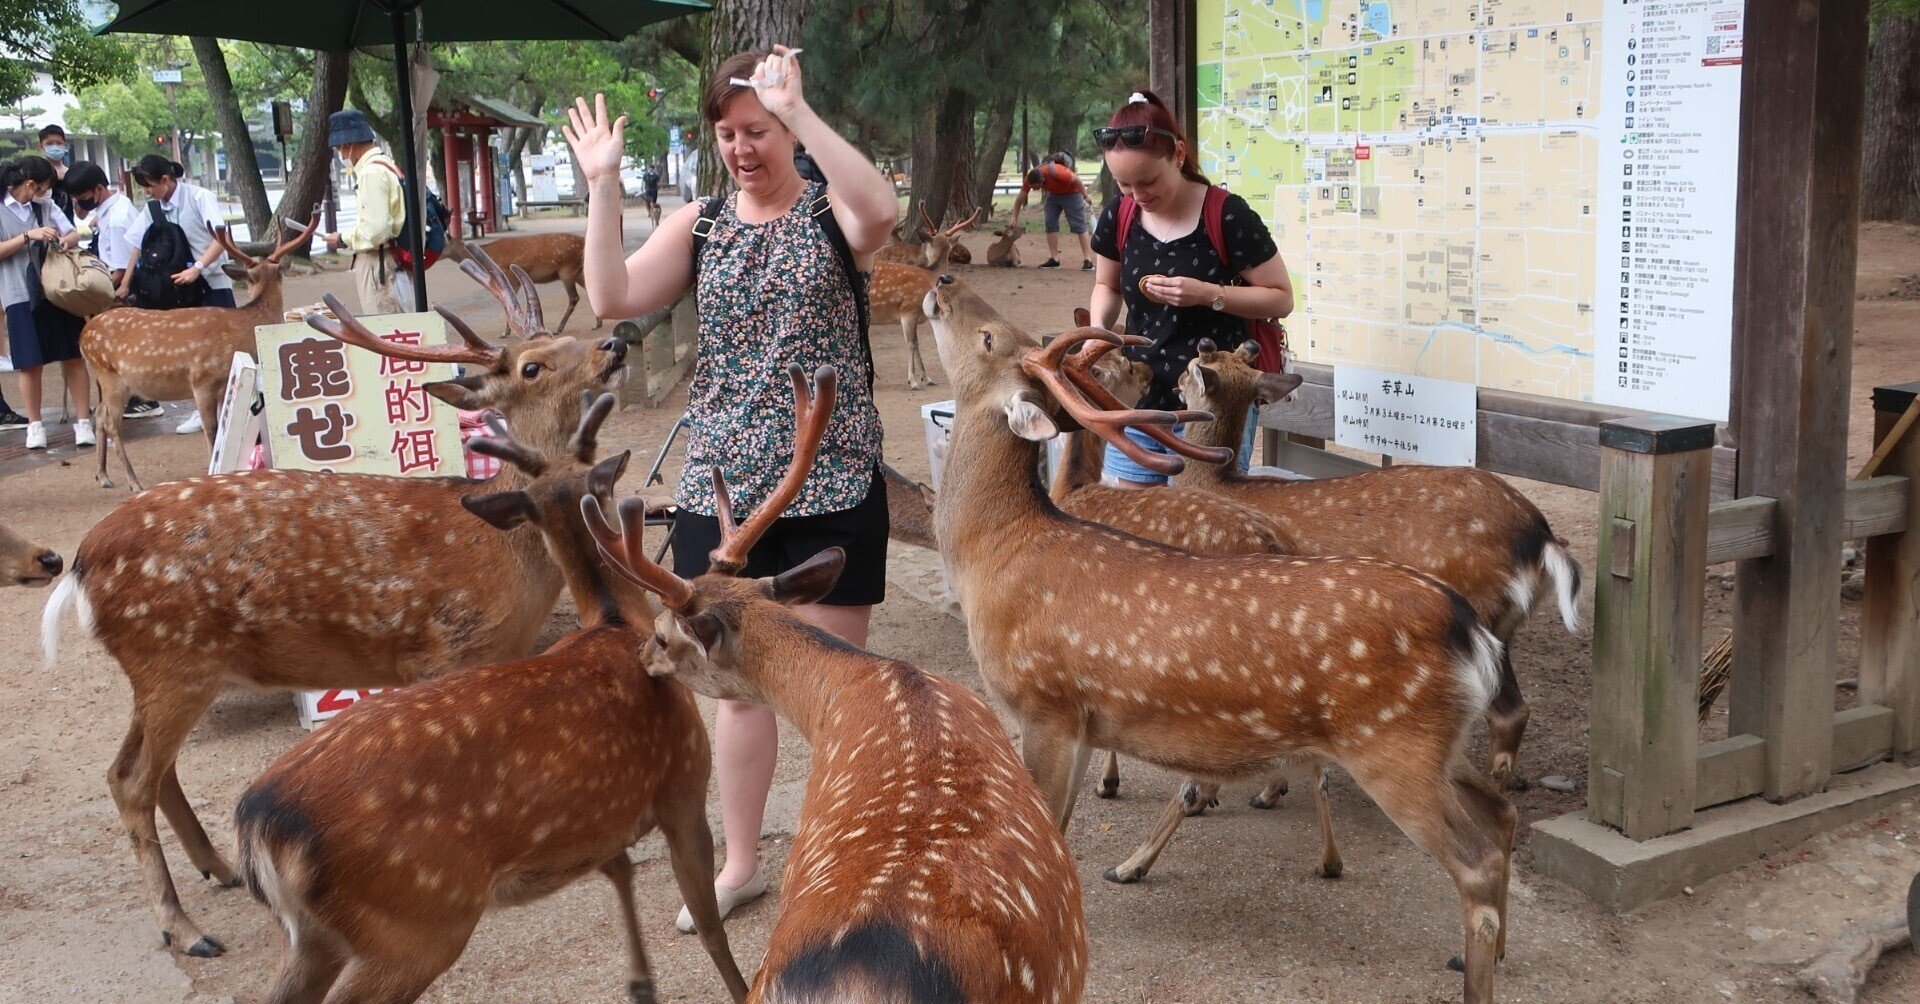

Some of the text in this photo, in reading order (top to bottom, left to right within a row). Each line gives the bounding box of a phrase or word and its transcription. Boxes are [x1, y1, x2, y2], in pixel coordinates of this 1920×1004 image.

[278, 337, 354, 473] 鹿せ
[1381, 379, 1415, 397] 若草山
